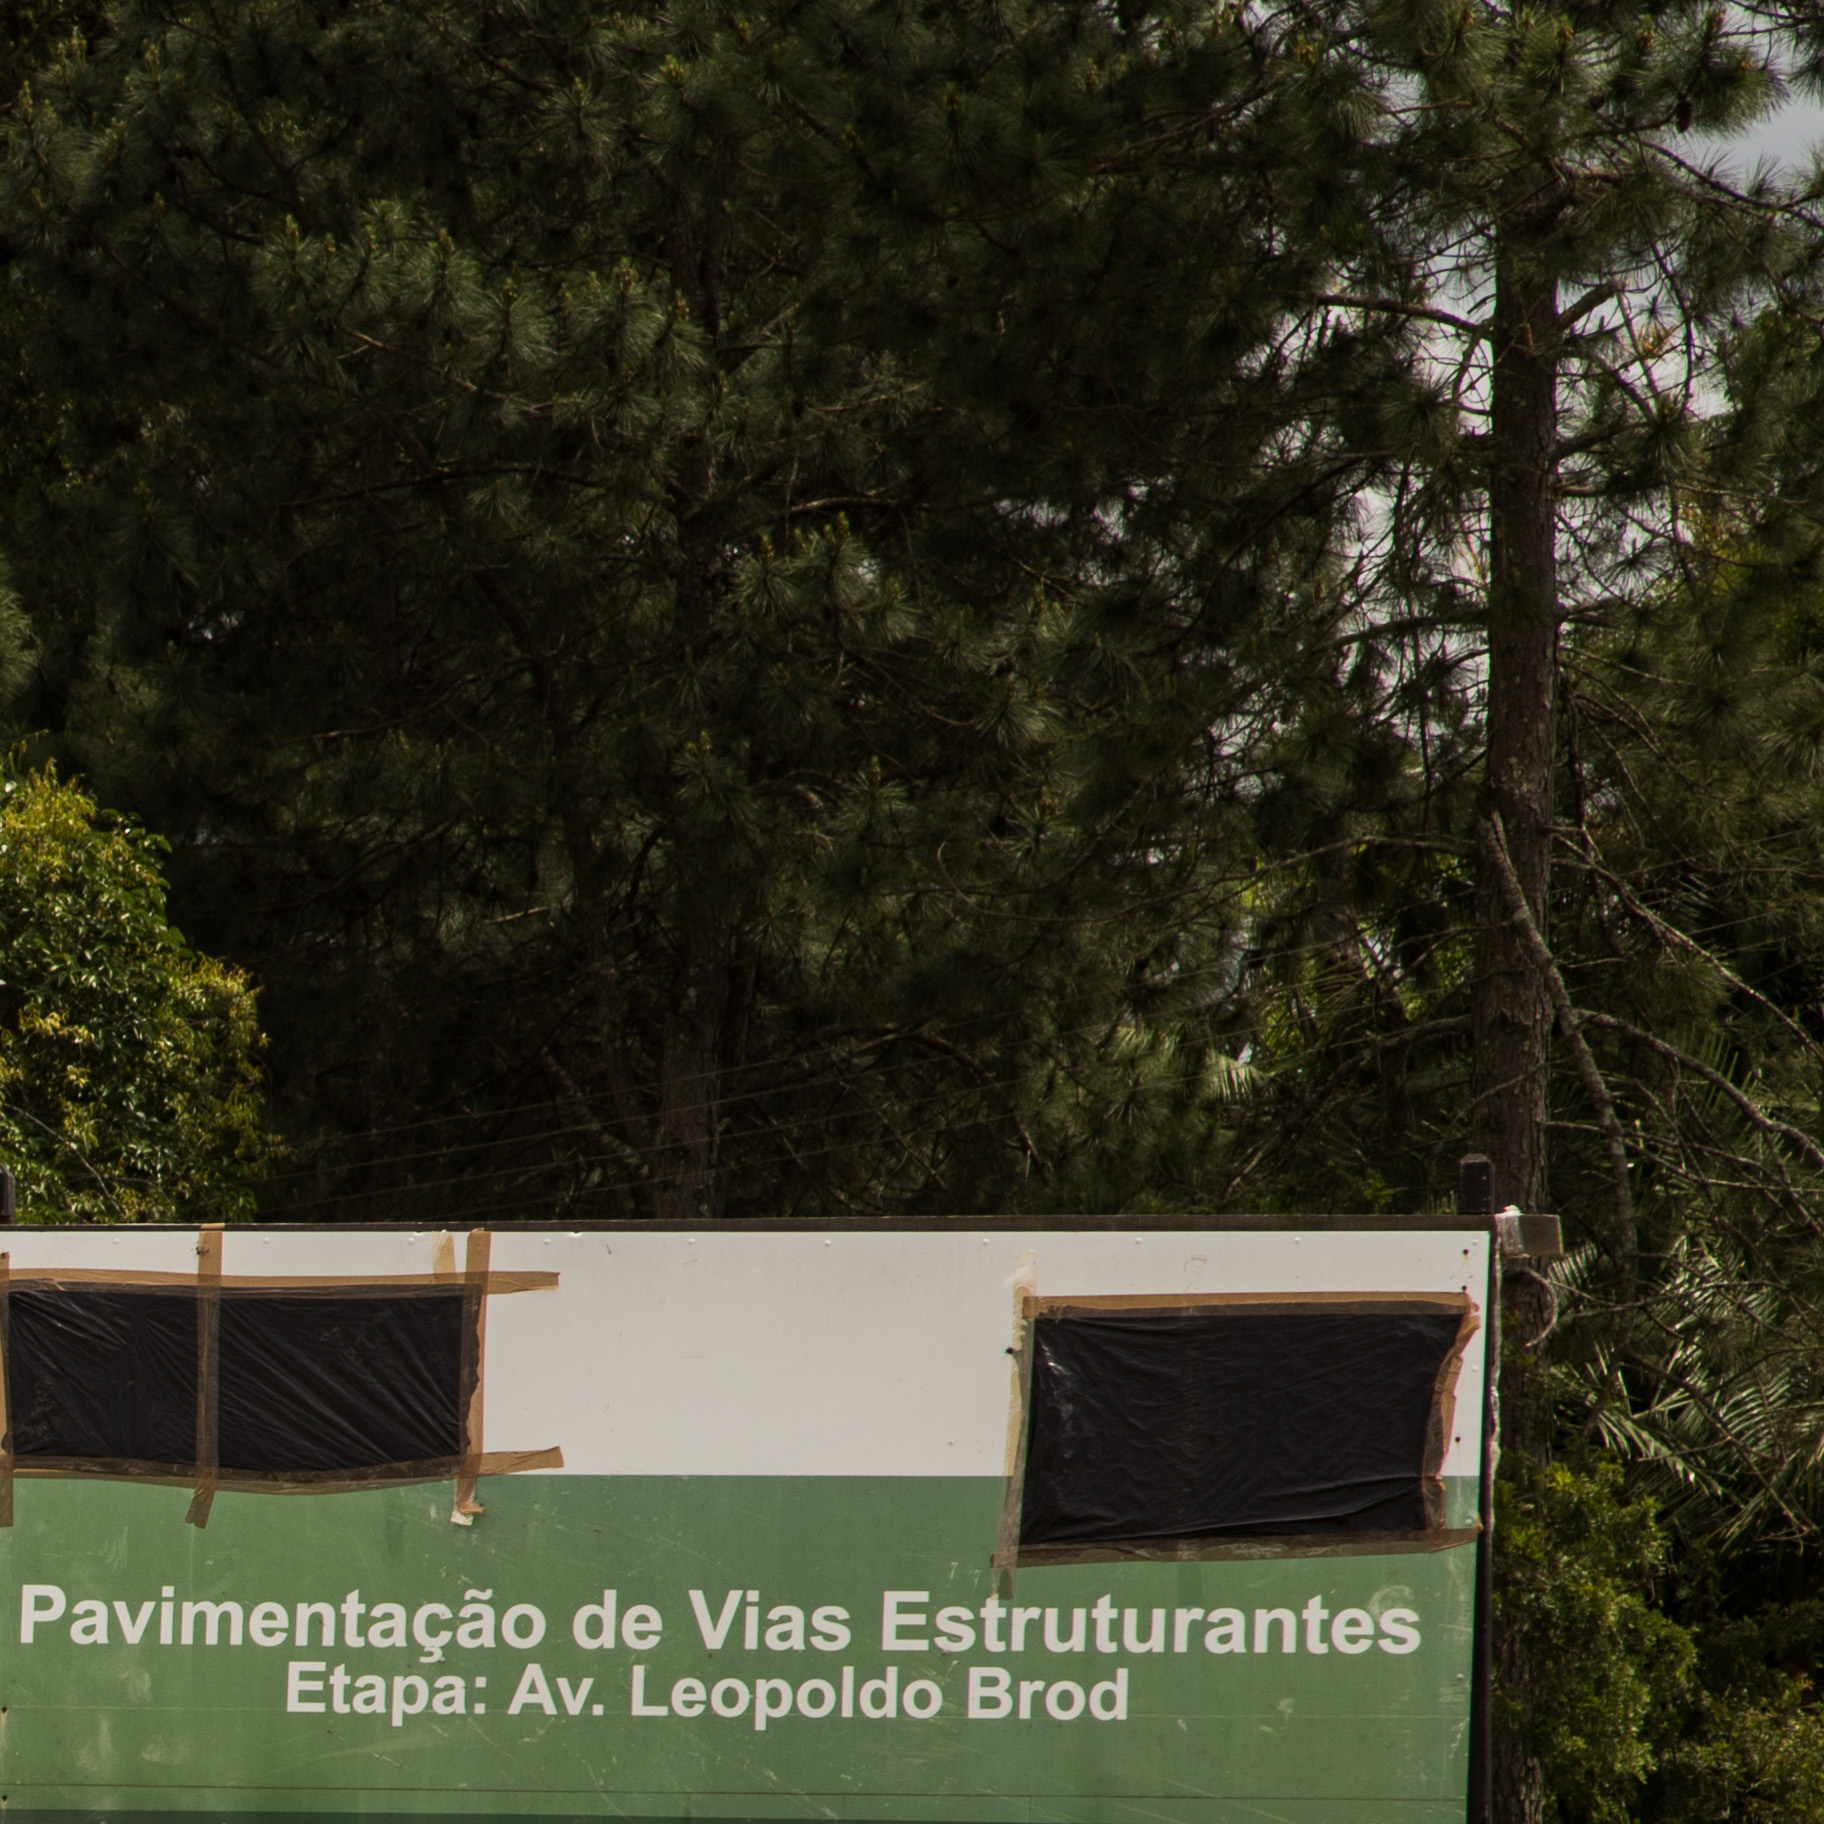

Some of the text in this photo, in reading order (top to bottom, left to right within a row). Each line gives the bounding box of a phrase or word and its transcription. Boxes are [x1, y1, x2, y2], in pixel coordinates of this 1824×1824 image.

[19, 1584, 1421, 1664] Pavimentação de Vias Estruturantes
[286, 1659, 1129, 1732] Etapa: Av. Leopoldo Brod
